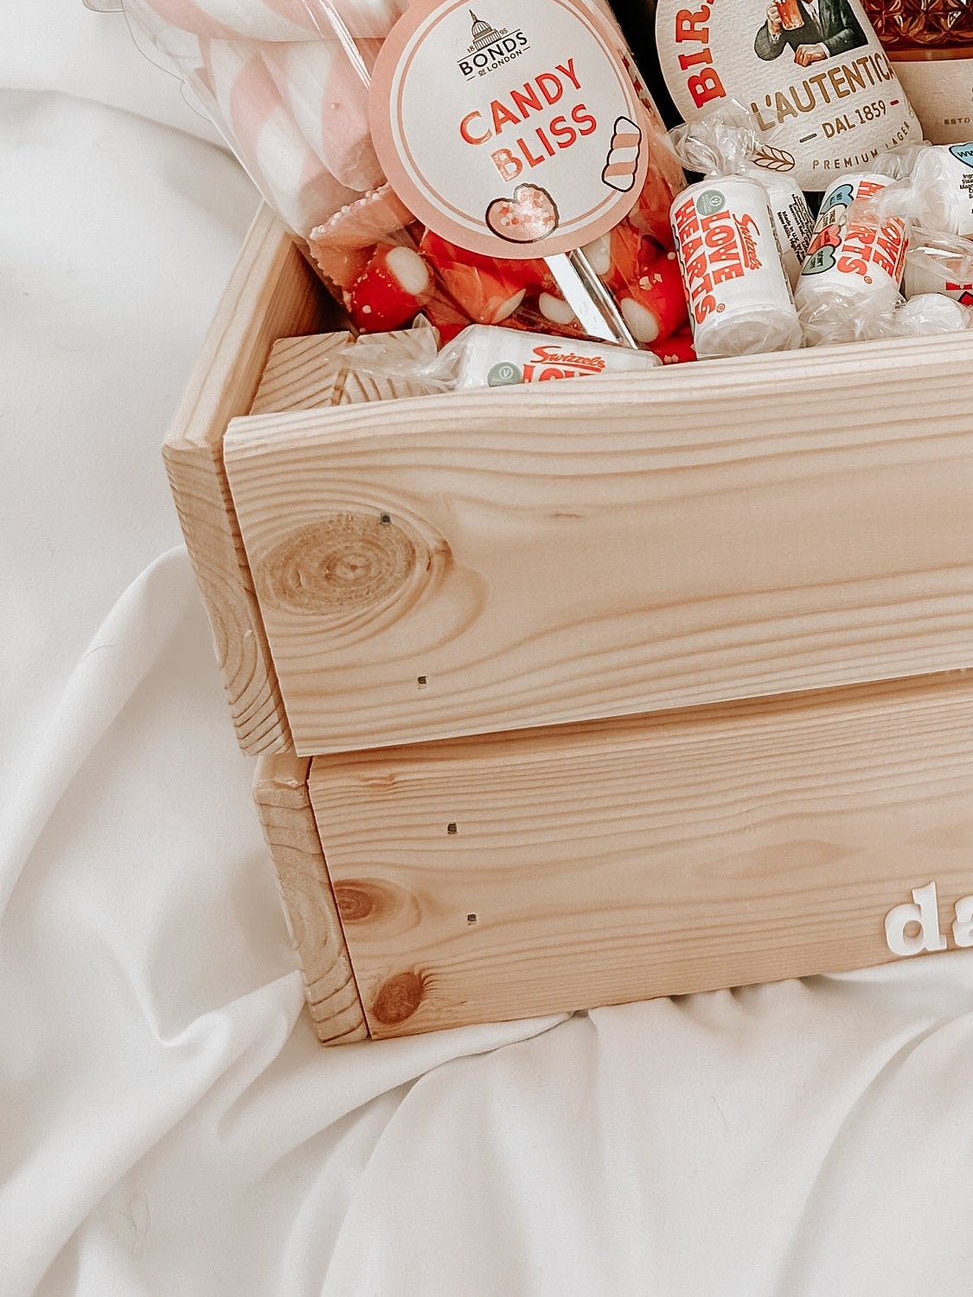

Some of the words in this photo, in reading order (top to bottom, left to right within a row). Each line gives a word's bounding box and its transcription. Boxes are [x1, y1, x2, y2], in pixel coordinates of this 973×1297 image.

[458, 31, 528, 78] BONDS
[467, 45, 475, 53] 18
[486, 49, 524, 73] LONDON
[459, 58, 583, 145] CANDY
[821, 118, 855, 140] DAL
[854, 100, 888, 126] 1859
[944, 117, 971, 125] ESTD
[490, 103, 598, 183] BLISS
[812, 149, 880, 170] PREMIUM
[675, 197, 716, 325] HEARTS
[700, 210, 745, 285] LOVE
[530, 345, 606, 369] Swizzels
